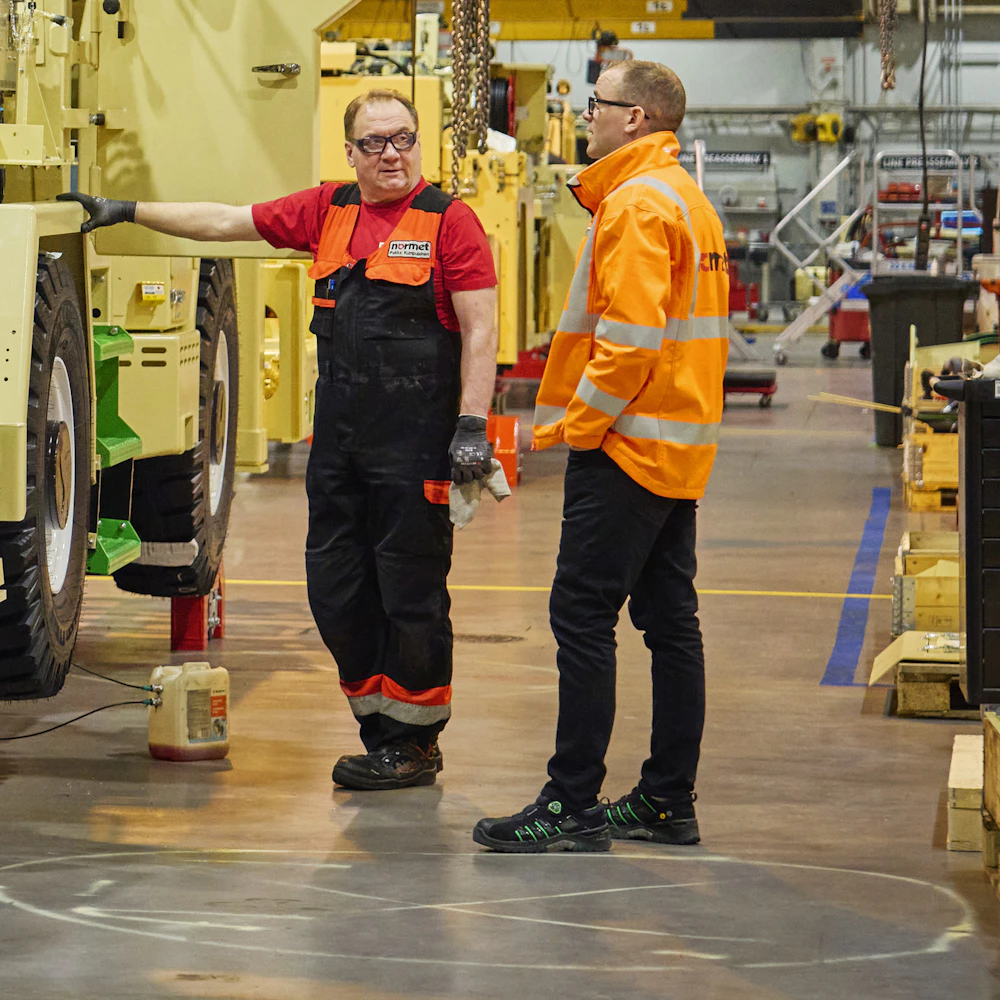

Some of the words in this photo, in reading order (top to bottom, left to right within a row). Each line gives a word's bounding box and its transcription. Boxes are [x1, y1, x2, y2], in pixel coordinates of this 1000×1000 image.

[703, 152, 761, 164] REASSEMBLY
[905, 155, 971, 168] PRESSEMLY
[391, 242, 430, 251] normet
